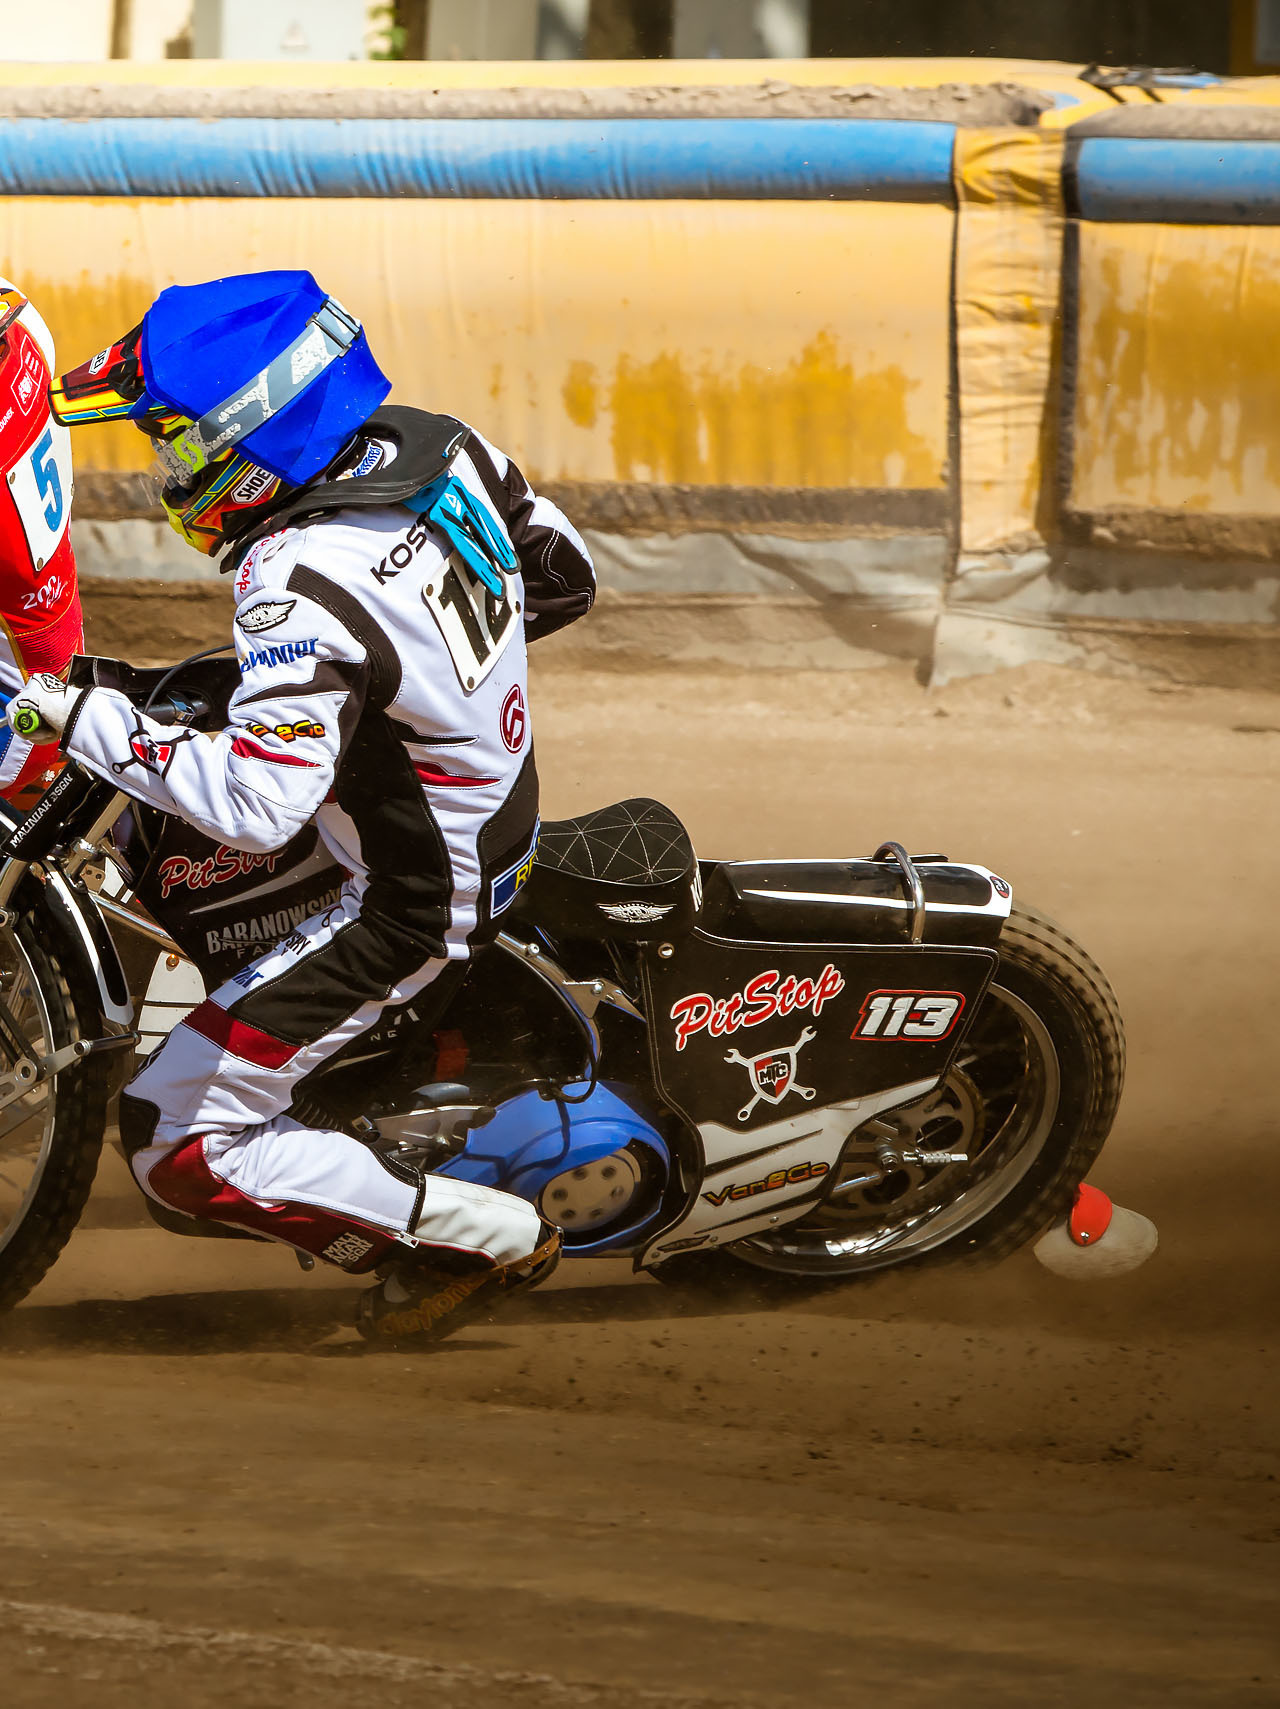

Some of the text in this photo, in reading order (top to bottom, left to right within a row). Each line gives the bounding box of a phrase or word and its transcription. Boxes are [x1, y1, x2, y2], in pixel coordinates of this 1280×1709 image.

[29, 428, 63, 532] 5
[238, 467, 270, 502] SHOE
[857, 996, 958, 1038] 113
[759, 1061, 790, 1086] MTC
